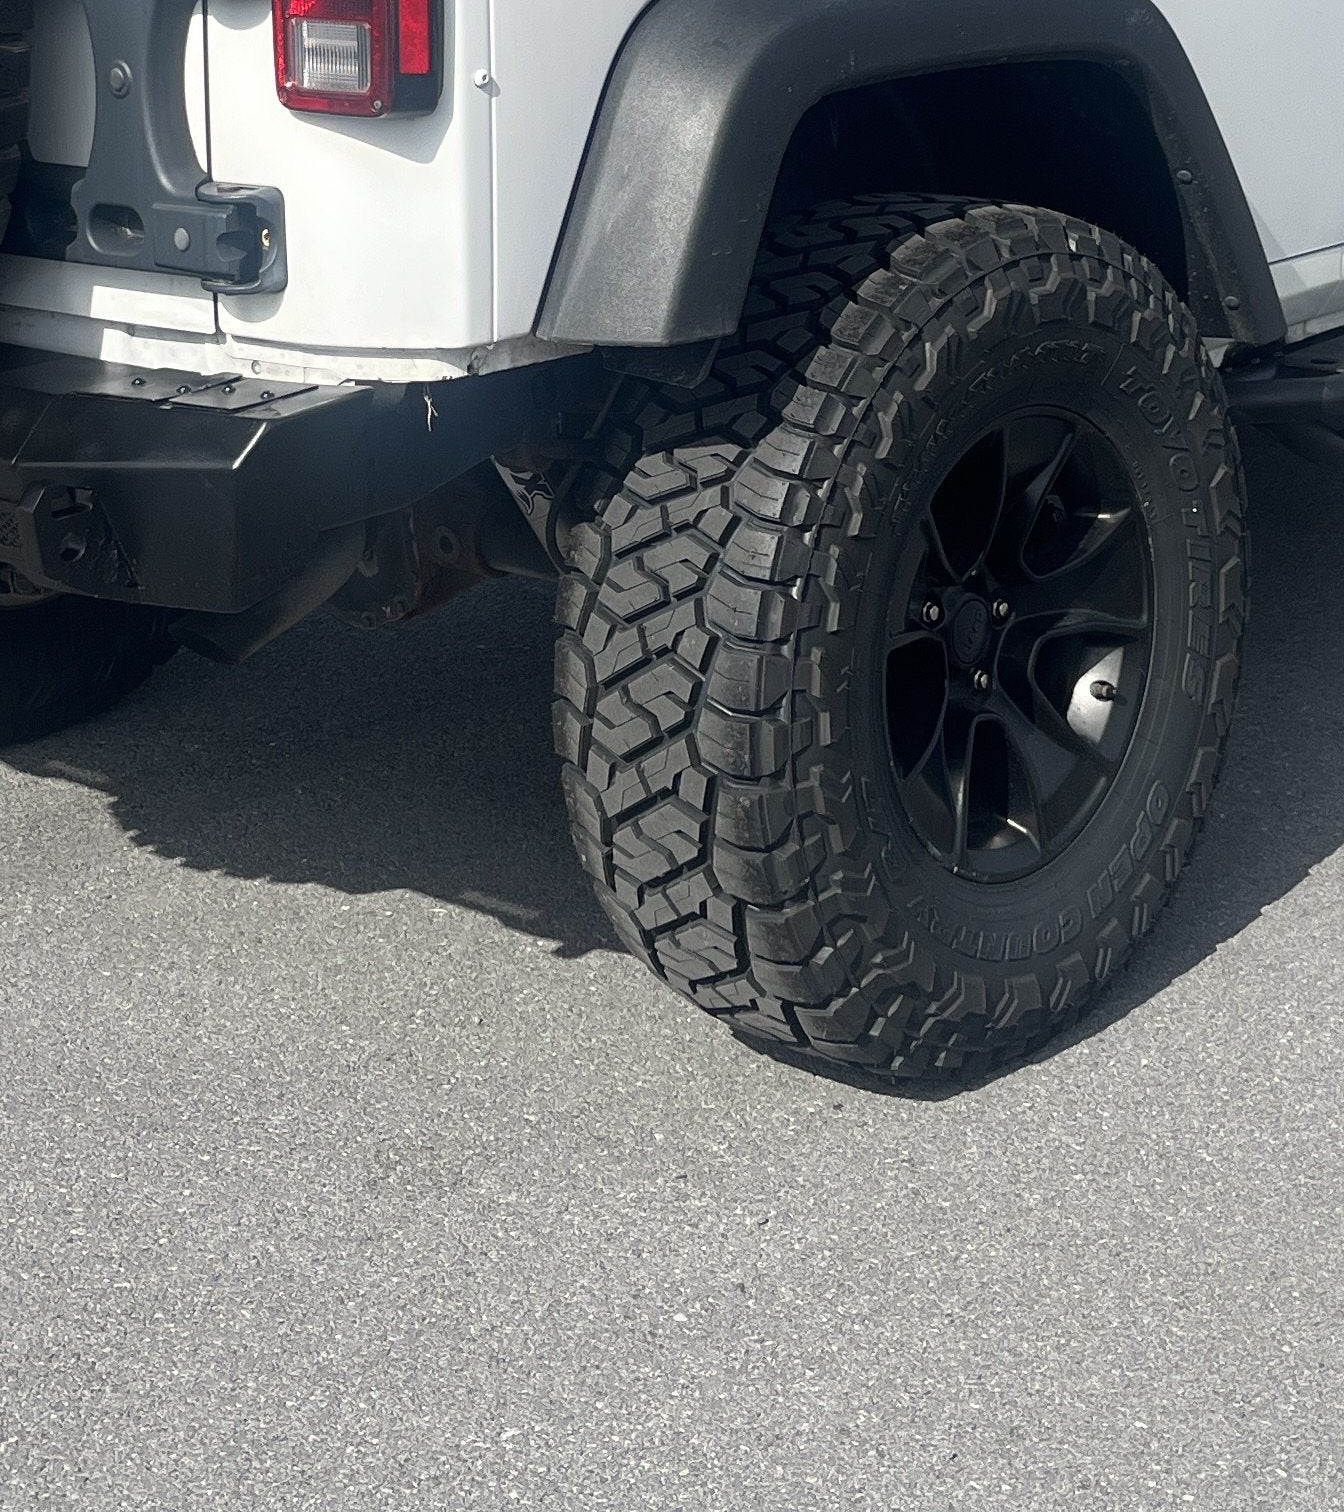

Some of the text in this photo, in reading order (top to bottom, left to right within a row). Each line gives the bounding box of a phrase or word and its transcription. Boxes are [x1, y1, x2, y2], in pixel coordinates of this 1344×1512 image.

[1119, 364, 1200, 493] TOYO
[1180, 498, 1215, 705] TIRES
[906, 778, 1170, 963] OPEN COUNTRY
